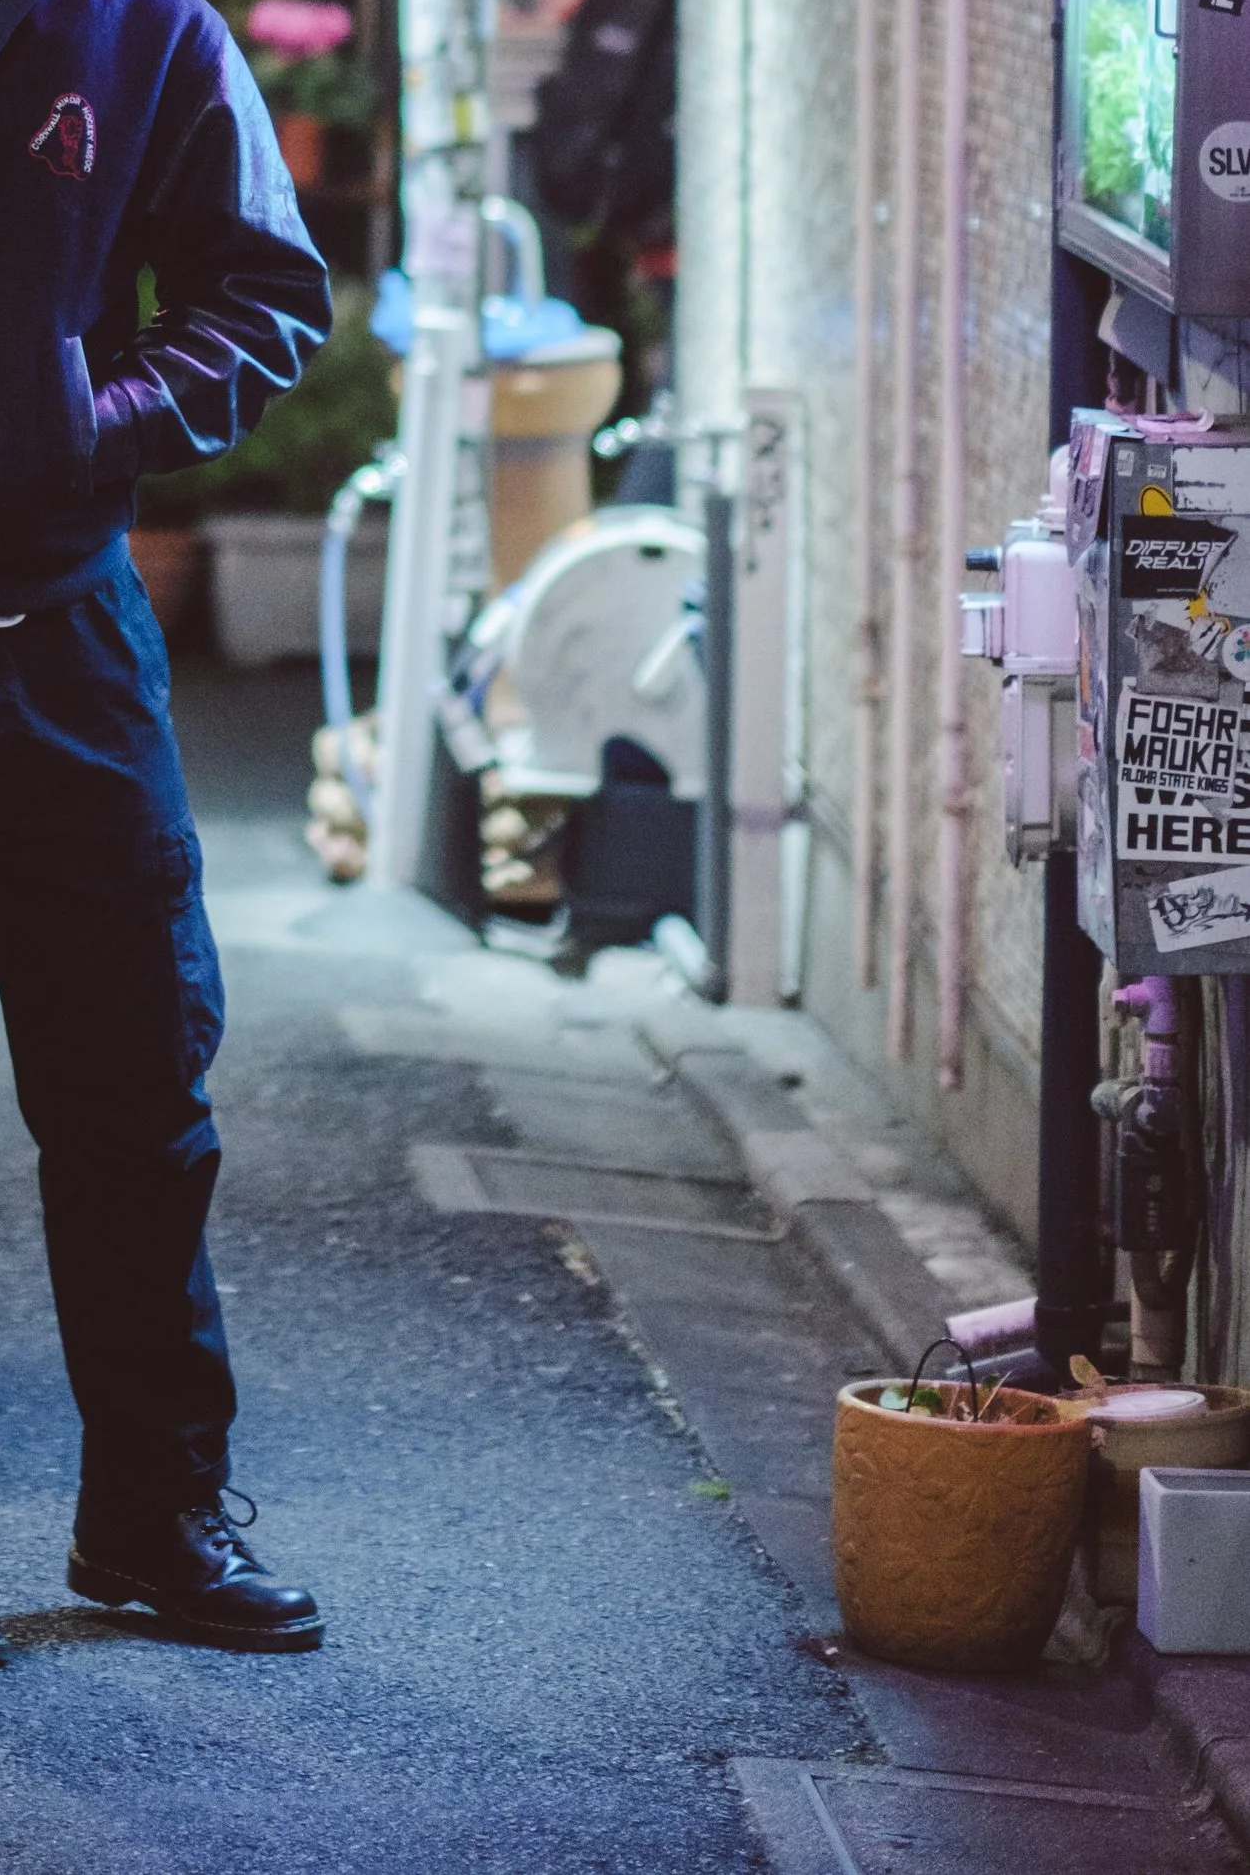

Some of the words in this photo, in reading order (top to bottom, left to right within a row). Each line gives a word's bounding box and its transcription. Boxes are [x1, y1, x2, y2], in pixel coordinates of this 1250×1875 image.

[31, 112, 61, 151] CORNWALL
[56, 96, 81, 111] MINOR
[82, 106, 94, 142] HOCKEY
[1123, 733, 1234, 778] MAUKA
[1159, 772, 1196, 789] STATE
[1197, 777, 1230, 794] KINGS
[1127, 813, 1250, 855] HERE
